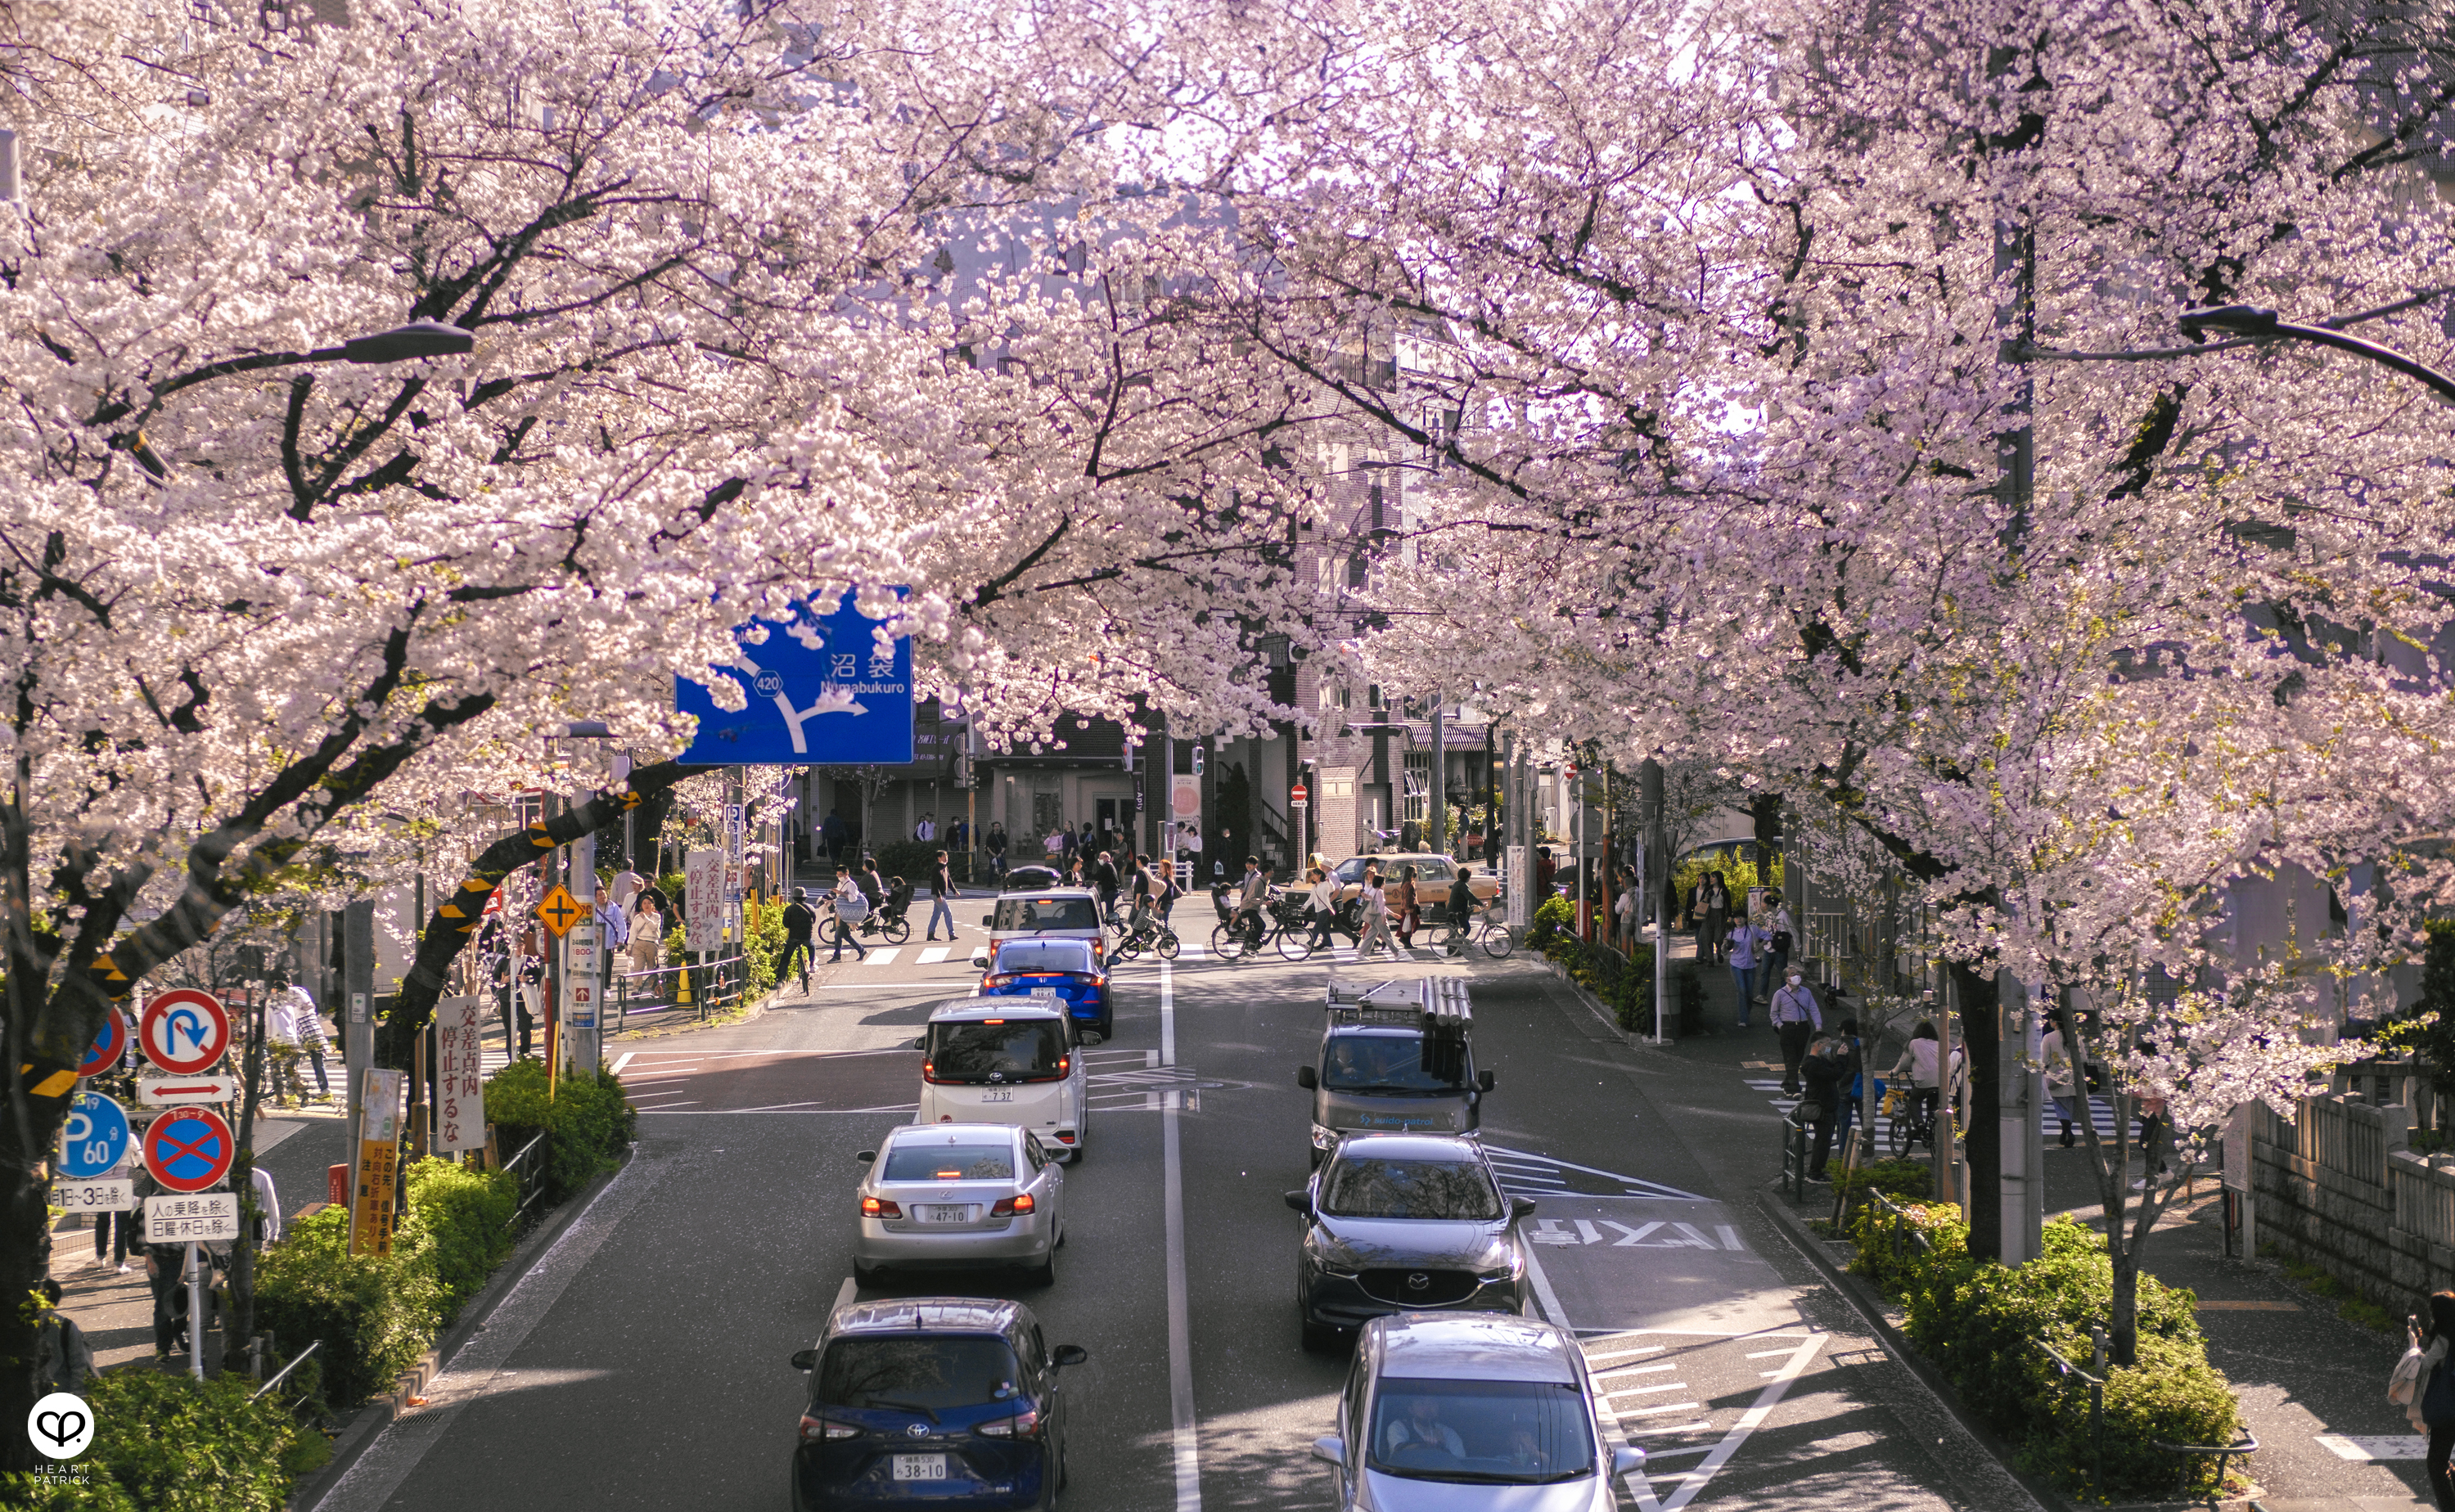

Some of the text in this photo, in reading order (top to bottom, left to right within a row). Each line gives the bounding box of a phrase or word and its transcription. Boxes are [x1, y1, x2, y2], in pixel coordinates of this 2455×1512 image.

[831, 654, 894, 678] 沼袋
[757, 677, 778, 691] 420
[821, 681, 905, 694] Numabukuro
[705, 858, 720, 919] 交差点内
[689, 870, 704, 945] 停止するな
[460, 1004, 479, 1098] 交差点内
[441, 1025, 460, 1143] 停止するな
[1374, 1116, 1434, 1126] suido-patrol
[61, 1113, 92, 1165] P
[83, 1141, 109, 1164] 60
[152, 1199, 230, 1218] 人の乗降を除く
[935, 1212, 964, 1222] 47-10
[1528, 1218, 1745, 1251] バス停
[904, 1464, 944, 1478] 38-10
[921, 1456, 935, 1464] 530
